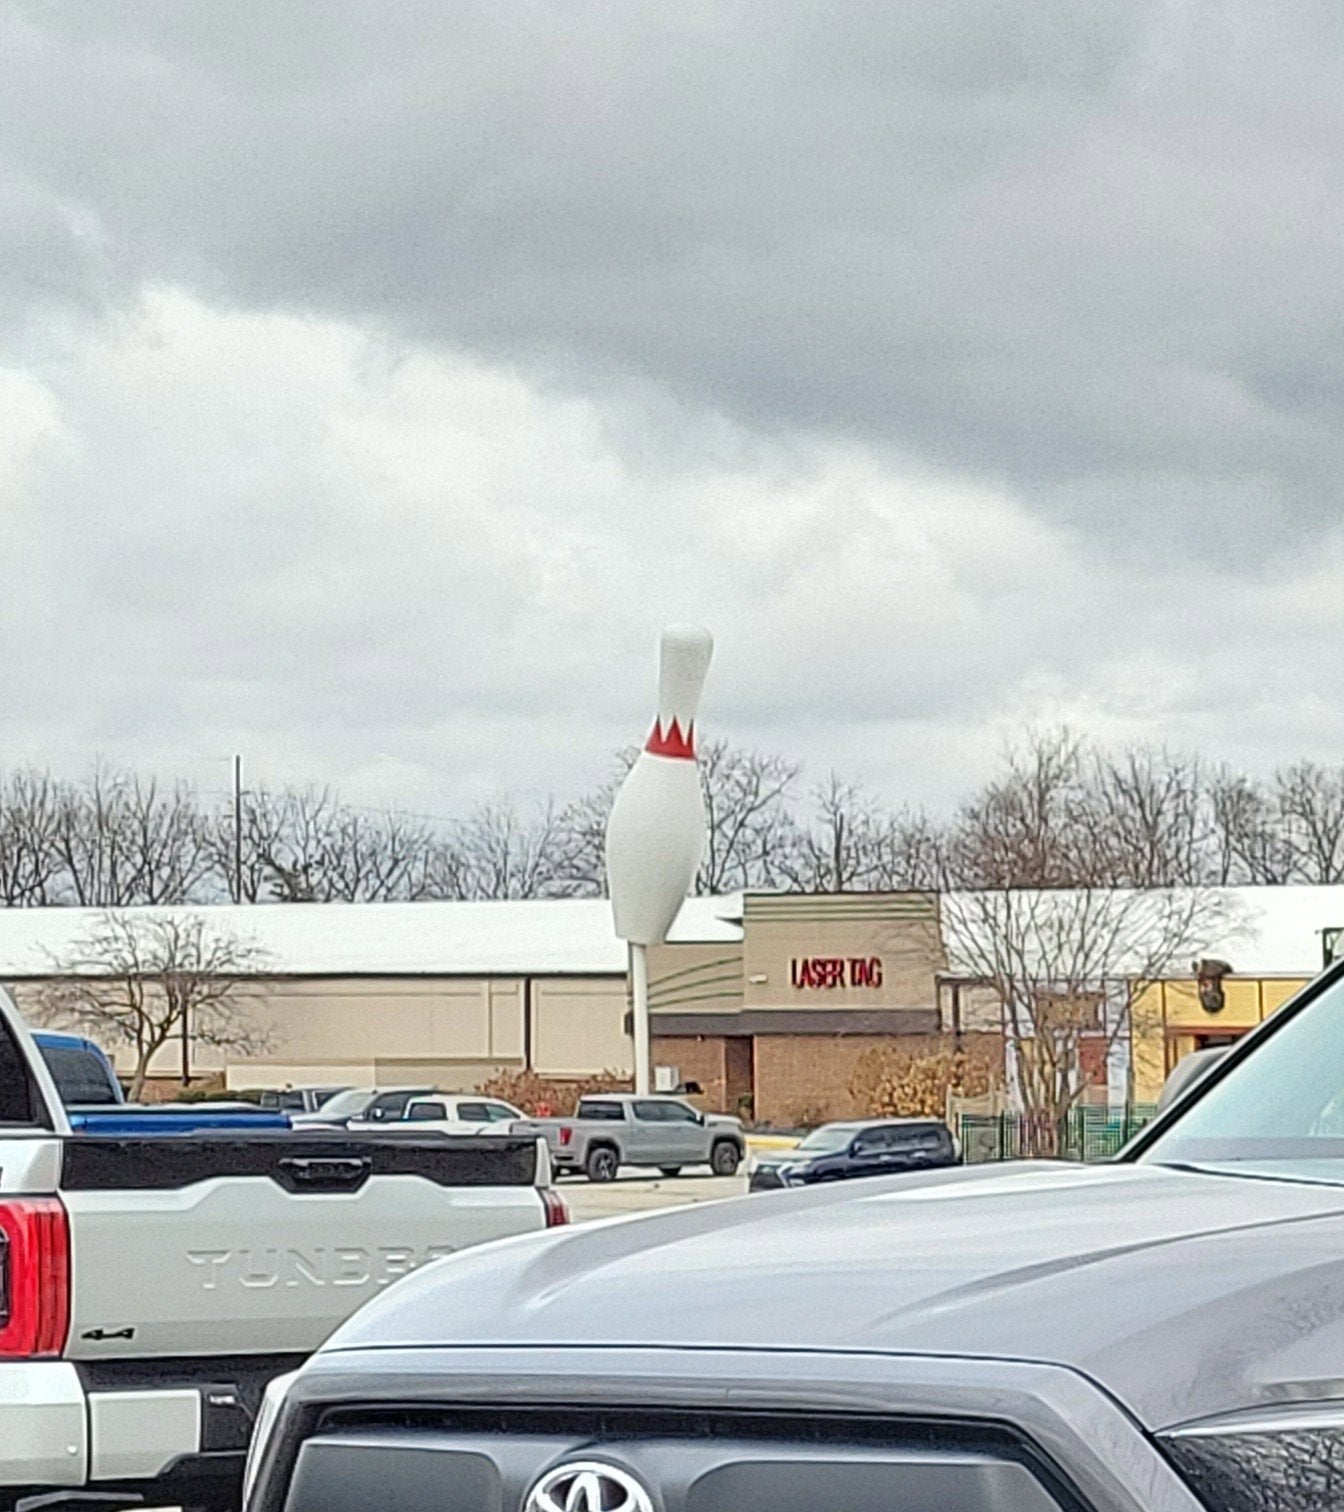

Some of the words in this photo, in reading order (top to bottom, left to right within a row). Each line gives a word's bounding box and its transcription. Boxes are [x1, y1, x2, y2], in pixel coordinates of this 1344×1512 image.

[790, 957, 846, 989] LASER
[847, 956, 883, 988] TAG
[186, 1245, 453, 1289] TUNDR
